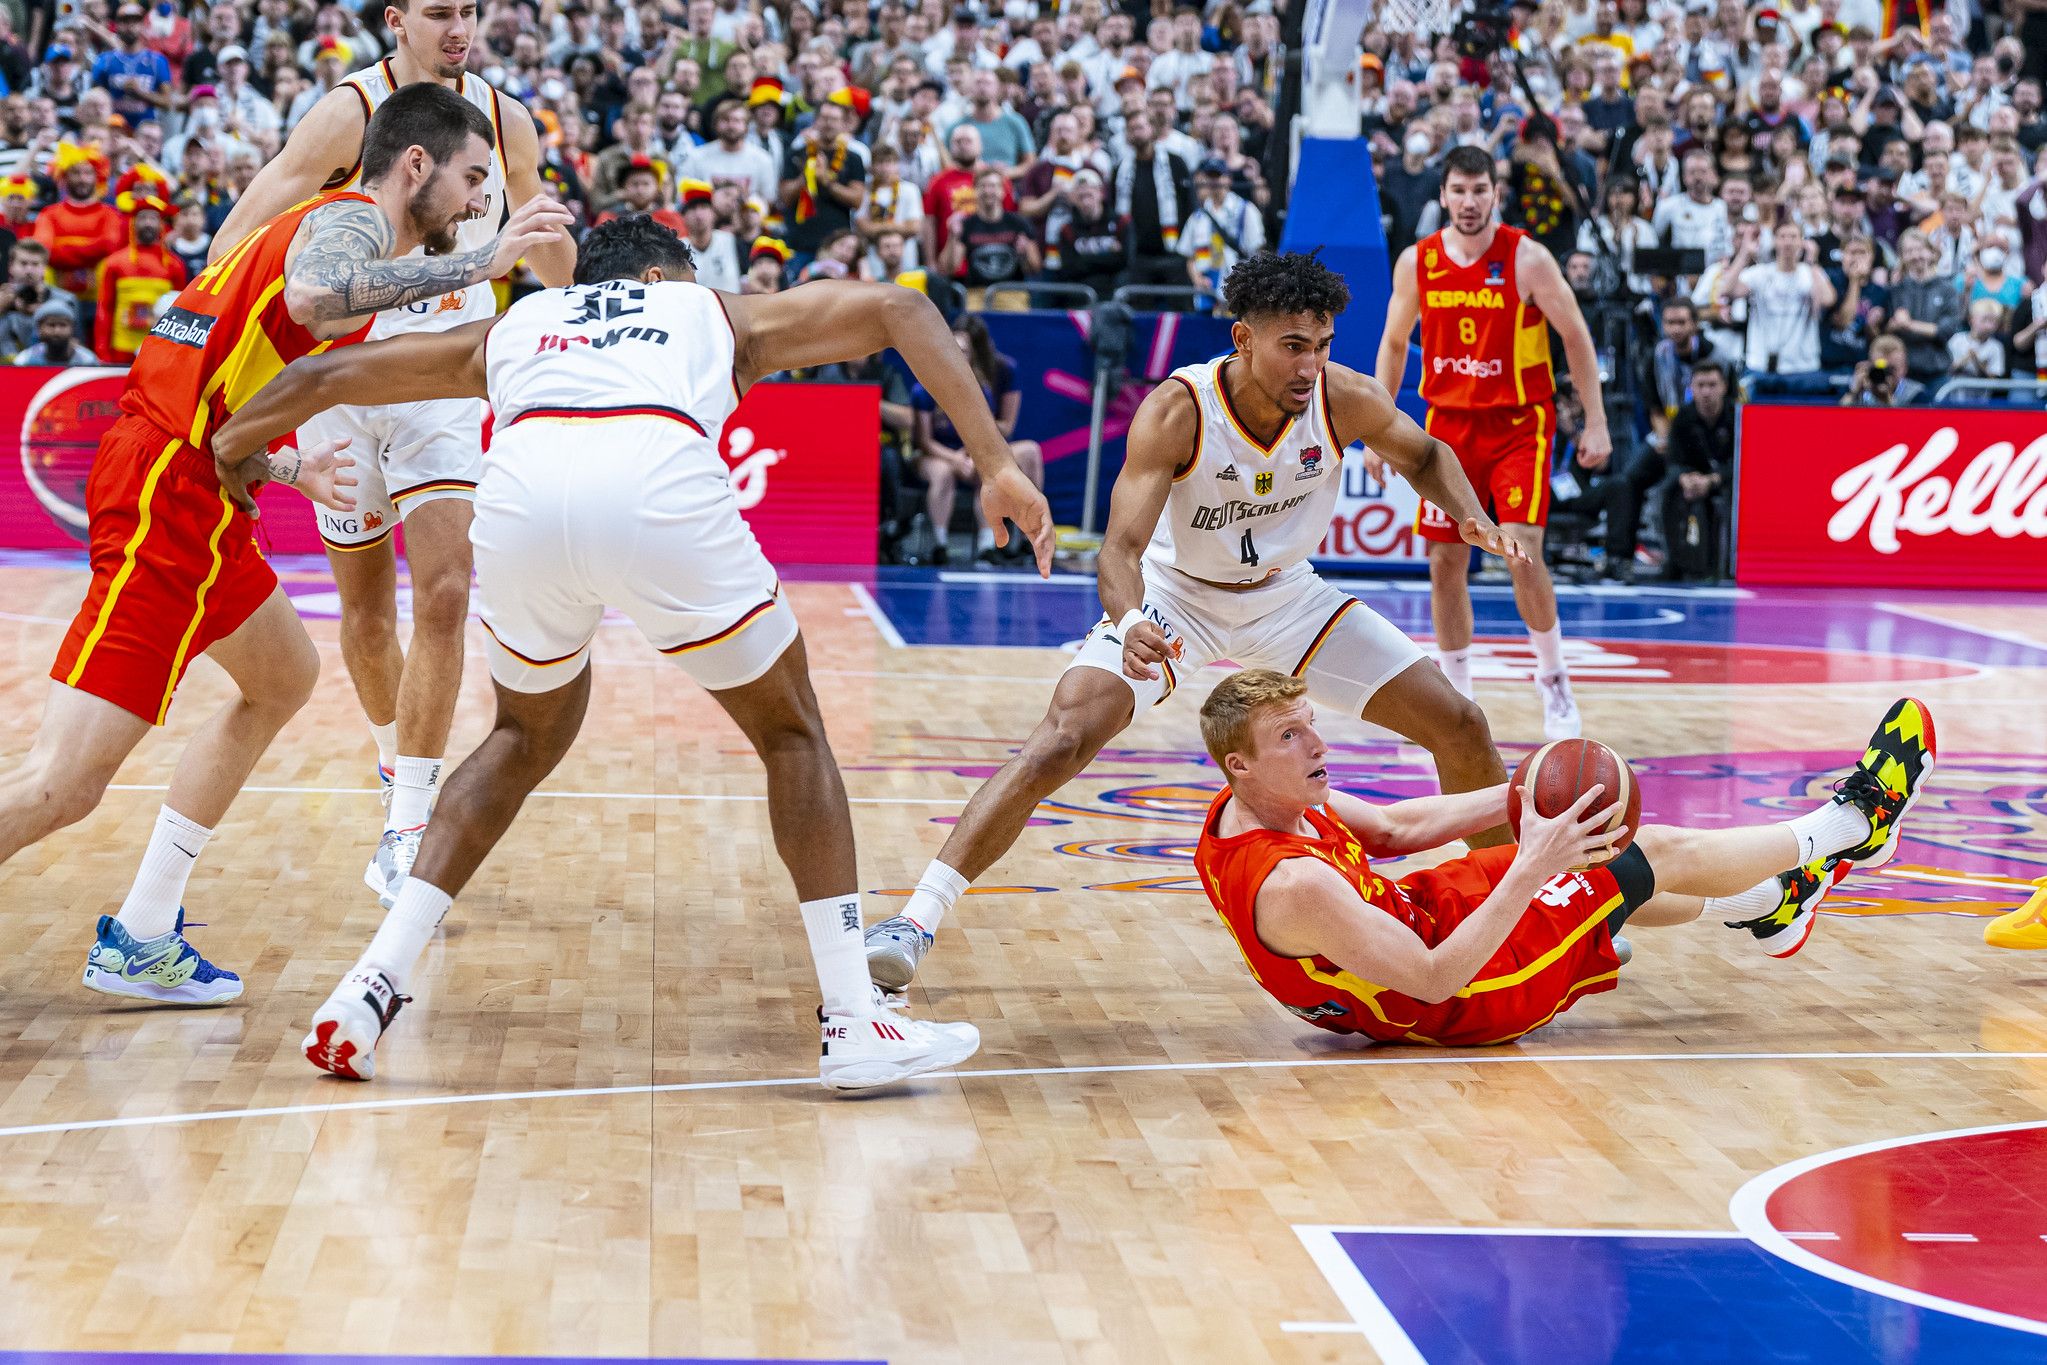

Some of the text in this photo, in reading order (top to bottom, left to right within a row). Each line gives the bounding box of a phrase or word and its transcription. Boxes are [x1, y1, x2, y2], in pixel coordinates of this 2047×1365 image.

[1426, 287, 1505, 309] ESPAÑA
[1458, 317, 1477, 345] 8
[1433, 354, 1503, 379] endesa
[1215, 472, 1239, 482] PEAK
[323, 514, 358, 535] ING
[1240, 527, 1260, 567] 4
[839, 902, 861, 933] PEAK
